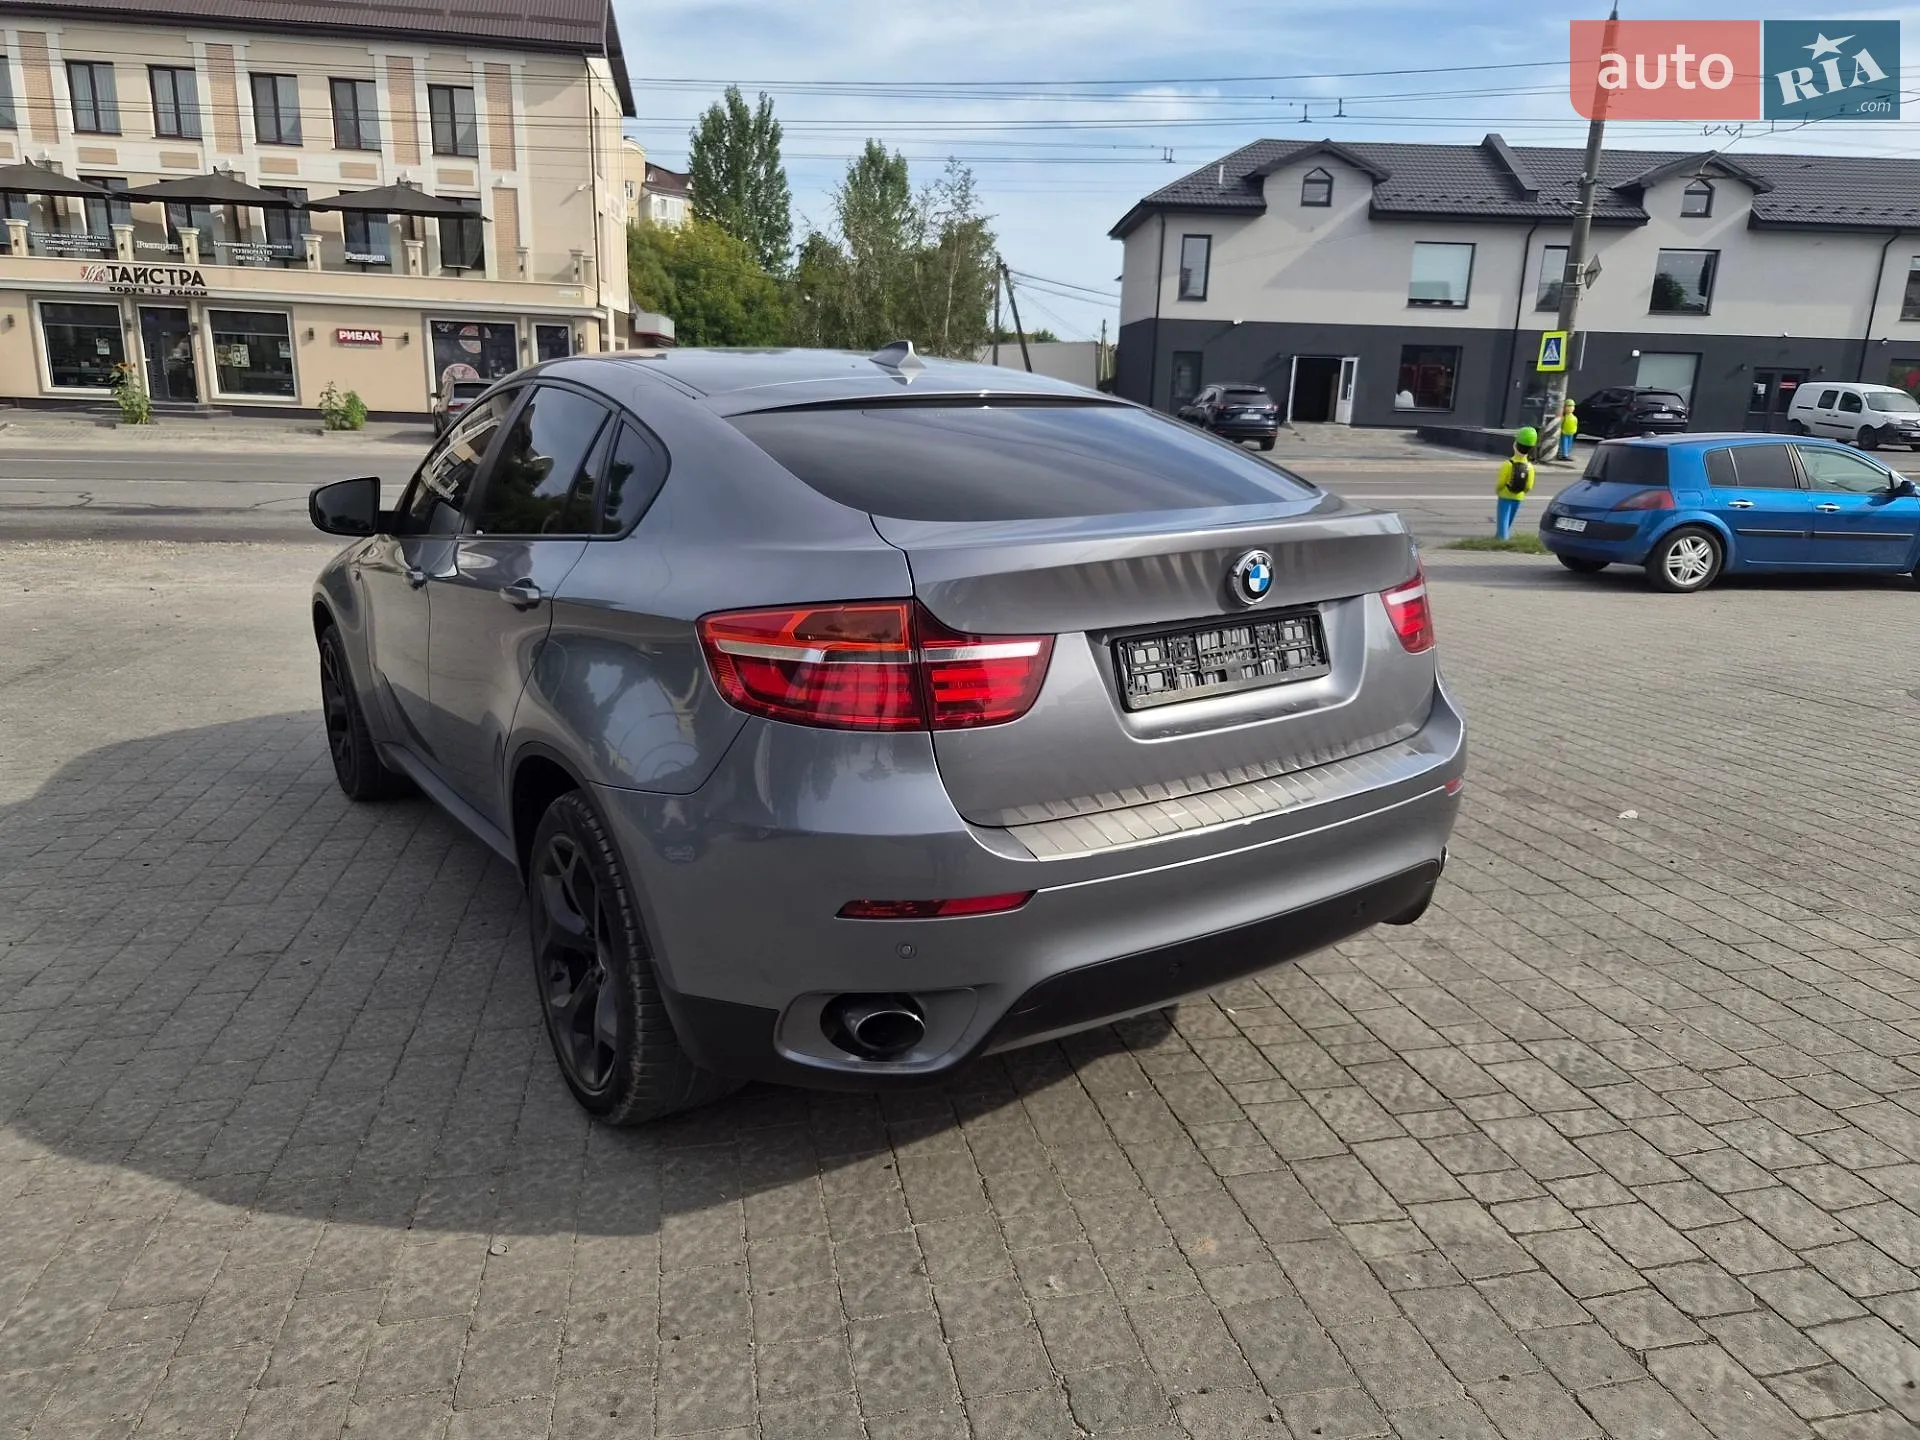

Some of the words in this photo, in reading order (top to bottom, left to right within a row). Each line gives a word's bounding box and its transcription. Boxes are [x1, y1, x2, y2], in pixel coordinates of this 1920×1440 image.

[106, 265, 206, 287] ТАЙСТРА
[169, 289, 208, 297] домом
[338, 330, 380, 341] РИБАК
